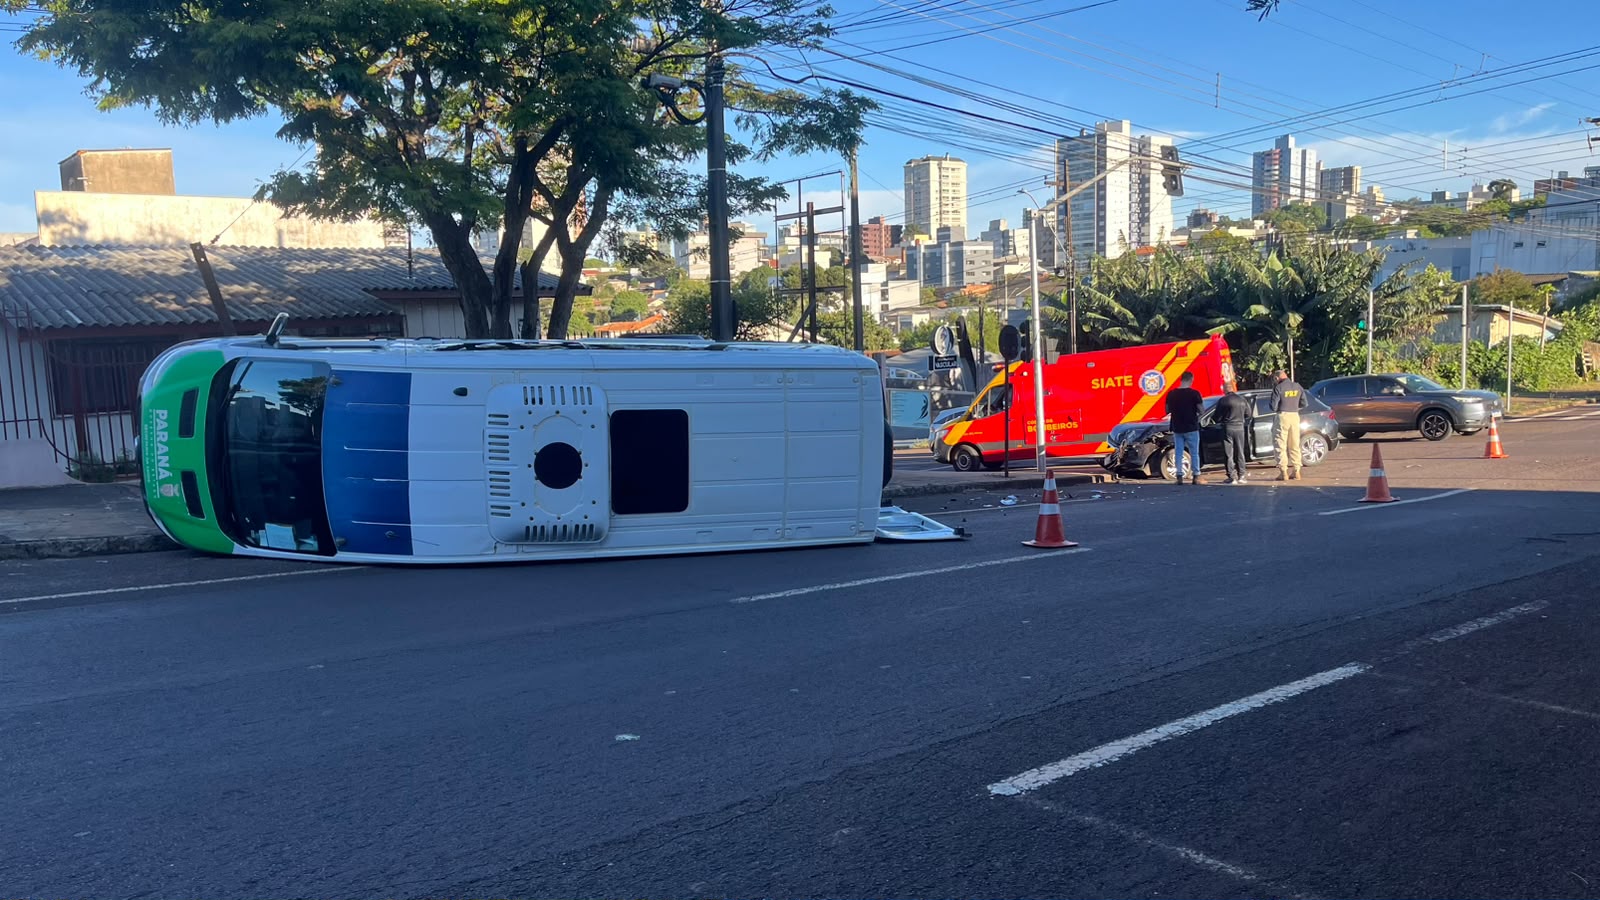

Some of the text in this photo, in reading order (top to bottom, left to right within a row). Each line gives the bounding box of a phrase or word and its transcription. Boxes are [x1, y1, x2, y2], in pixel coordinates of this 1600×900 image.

[1091, 375, 1134, 390] SIATE
[1284, 389, 1299, 398] PRF
[1027, 422, 1078, 432] BOBEIROS
[156, 409, 173, 480] PARANÁ
